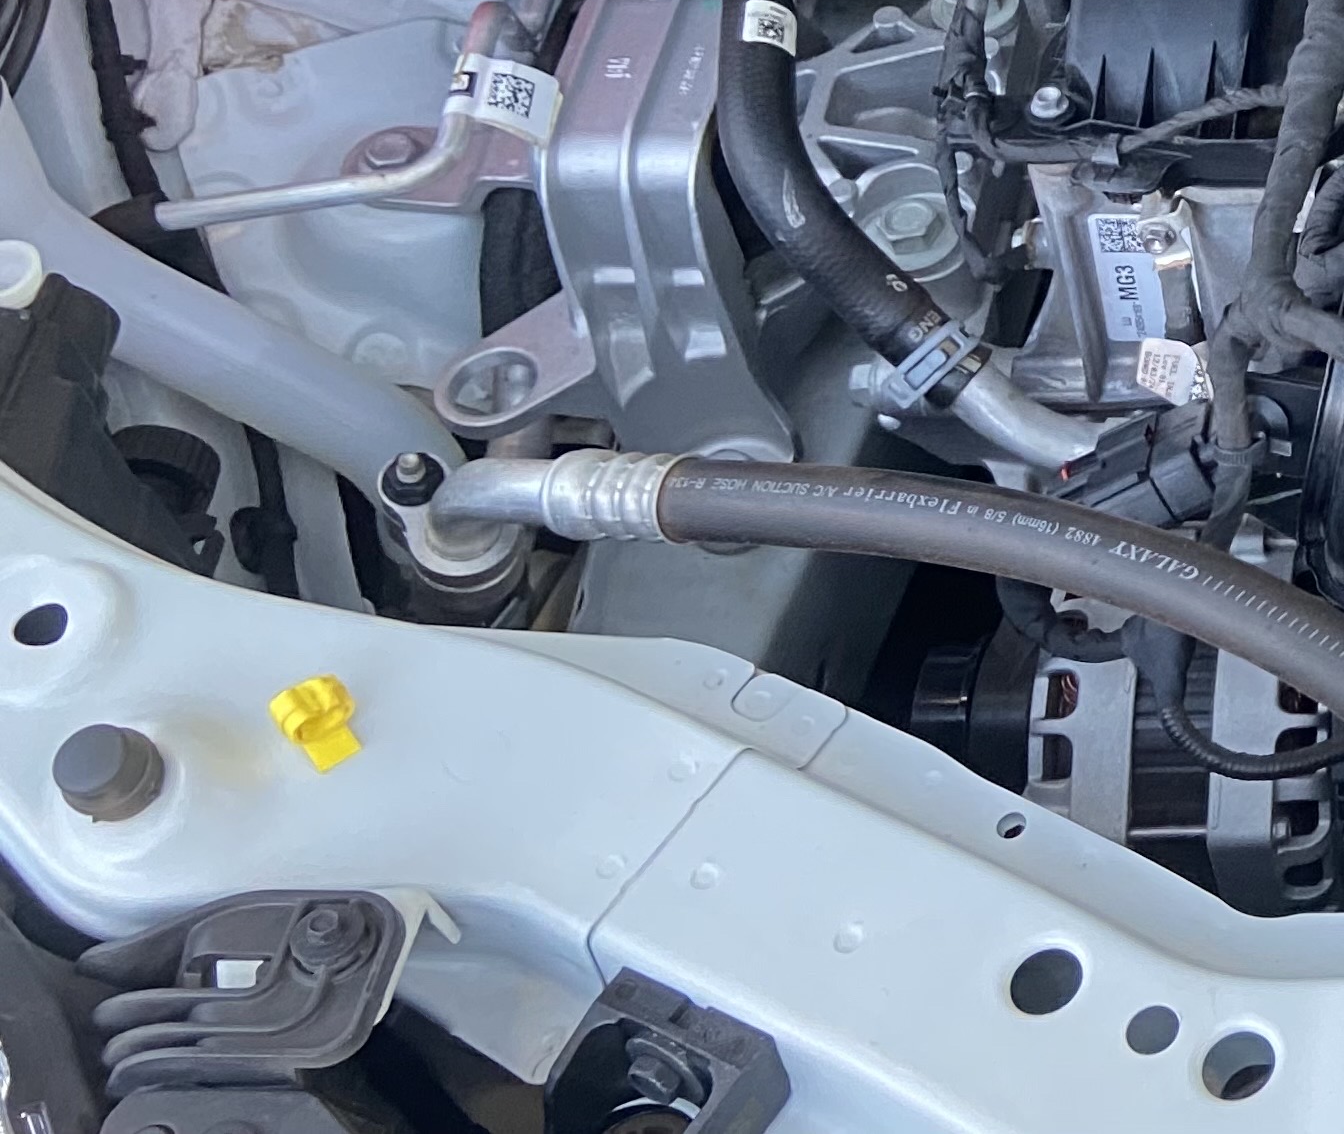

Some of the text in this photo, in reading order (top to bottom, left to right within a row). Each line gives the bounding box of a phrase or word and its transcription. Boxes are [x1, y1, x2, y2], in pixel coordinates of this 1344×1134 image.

[1114, 265, 1139, 301] MG3
[710, 477, 748, 491] HOSE
[751, 479, 811, 496] SUCTION
[844, 485, 962, 516] Flexbarrier
[984, 508, 1007, 524] 5/8
[1012, 512, 1060, 536] (16mm)
[1065, 526, 1101, 547] 4882
[1109, 539, 1199, 581] GALAXY
